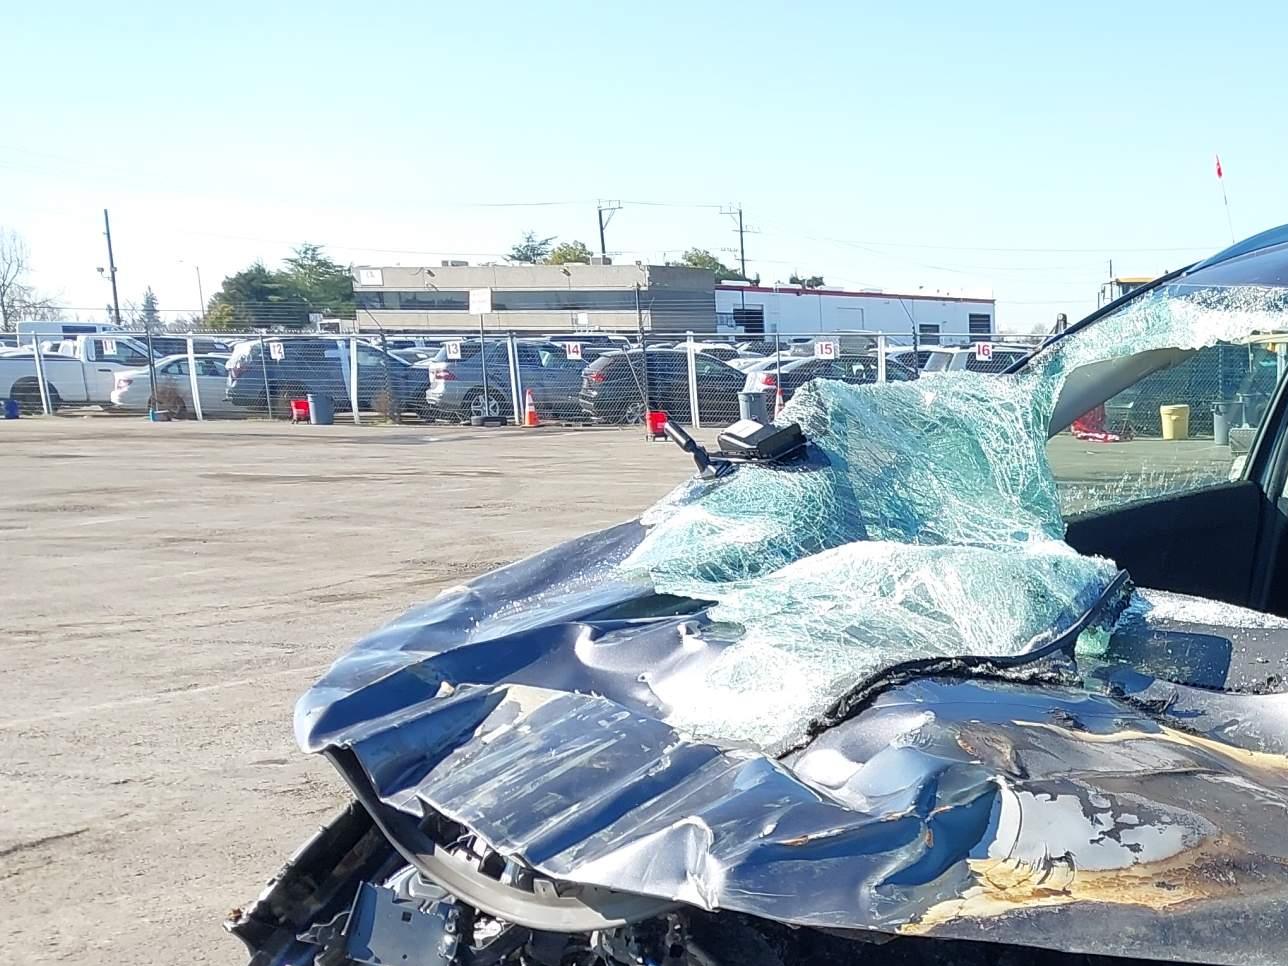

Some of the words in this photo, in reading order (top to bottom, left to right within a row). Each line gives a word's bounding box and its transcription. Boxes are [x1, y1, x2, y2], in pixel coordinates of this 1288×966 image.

[448, 343, 459, 354] 13
[568, 343, 579, 355] 14
[820, 343, 832, 355] 15
[978, 343, 991, 356] 16
